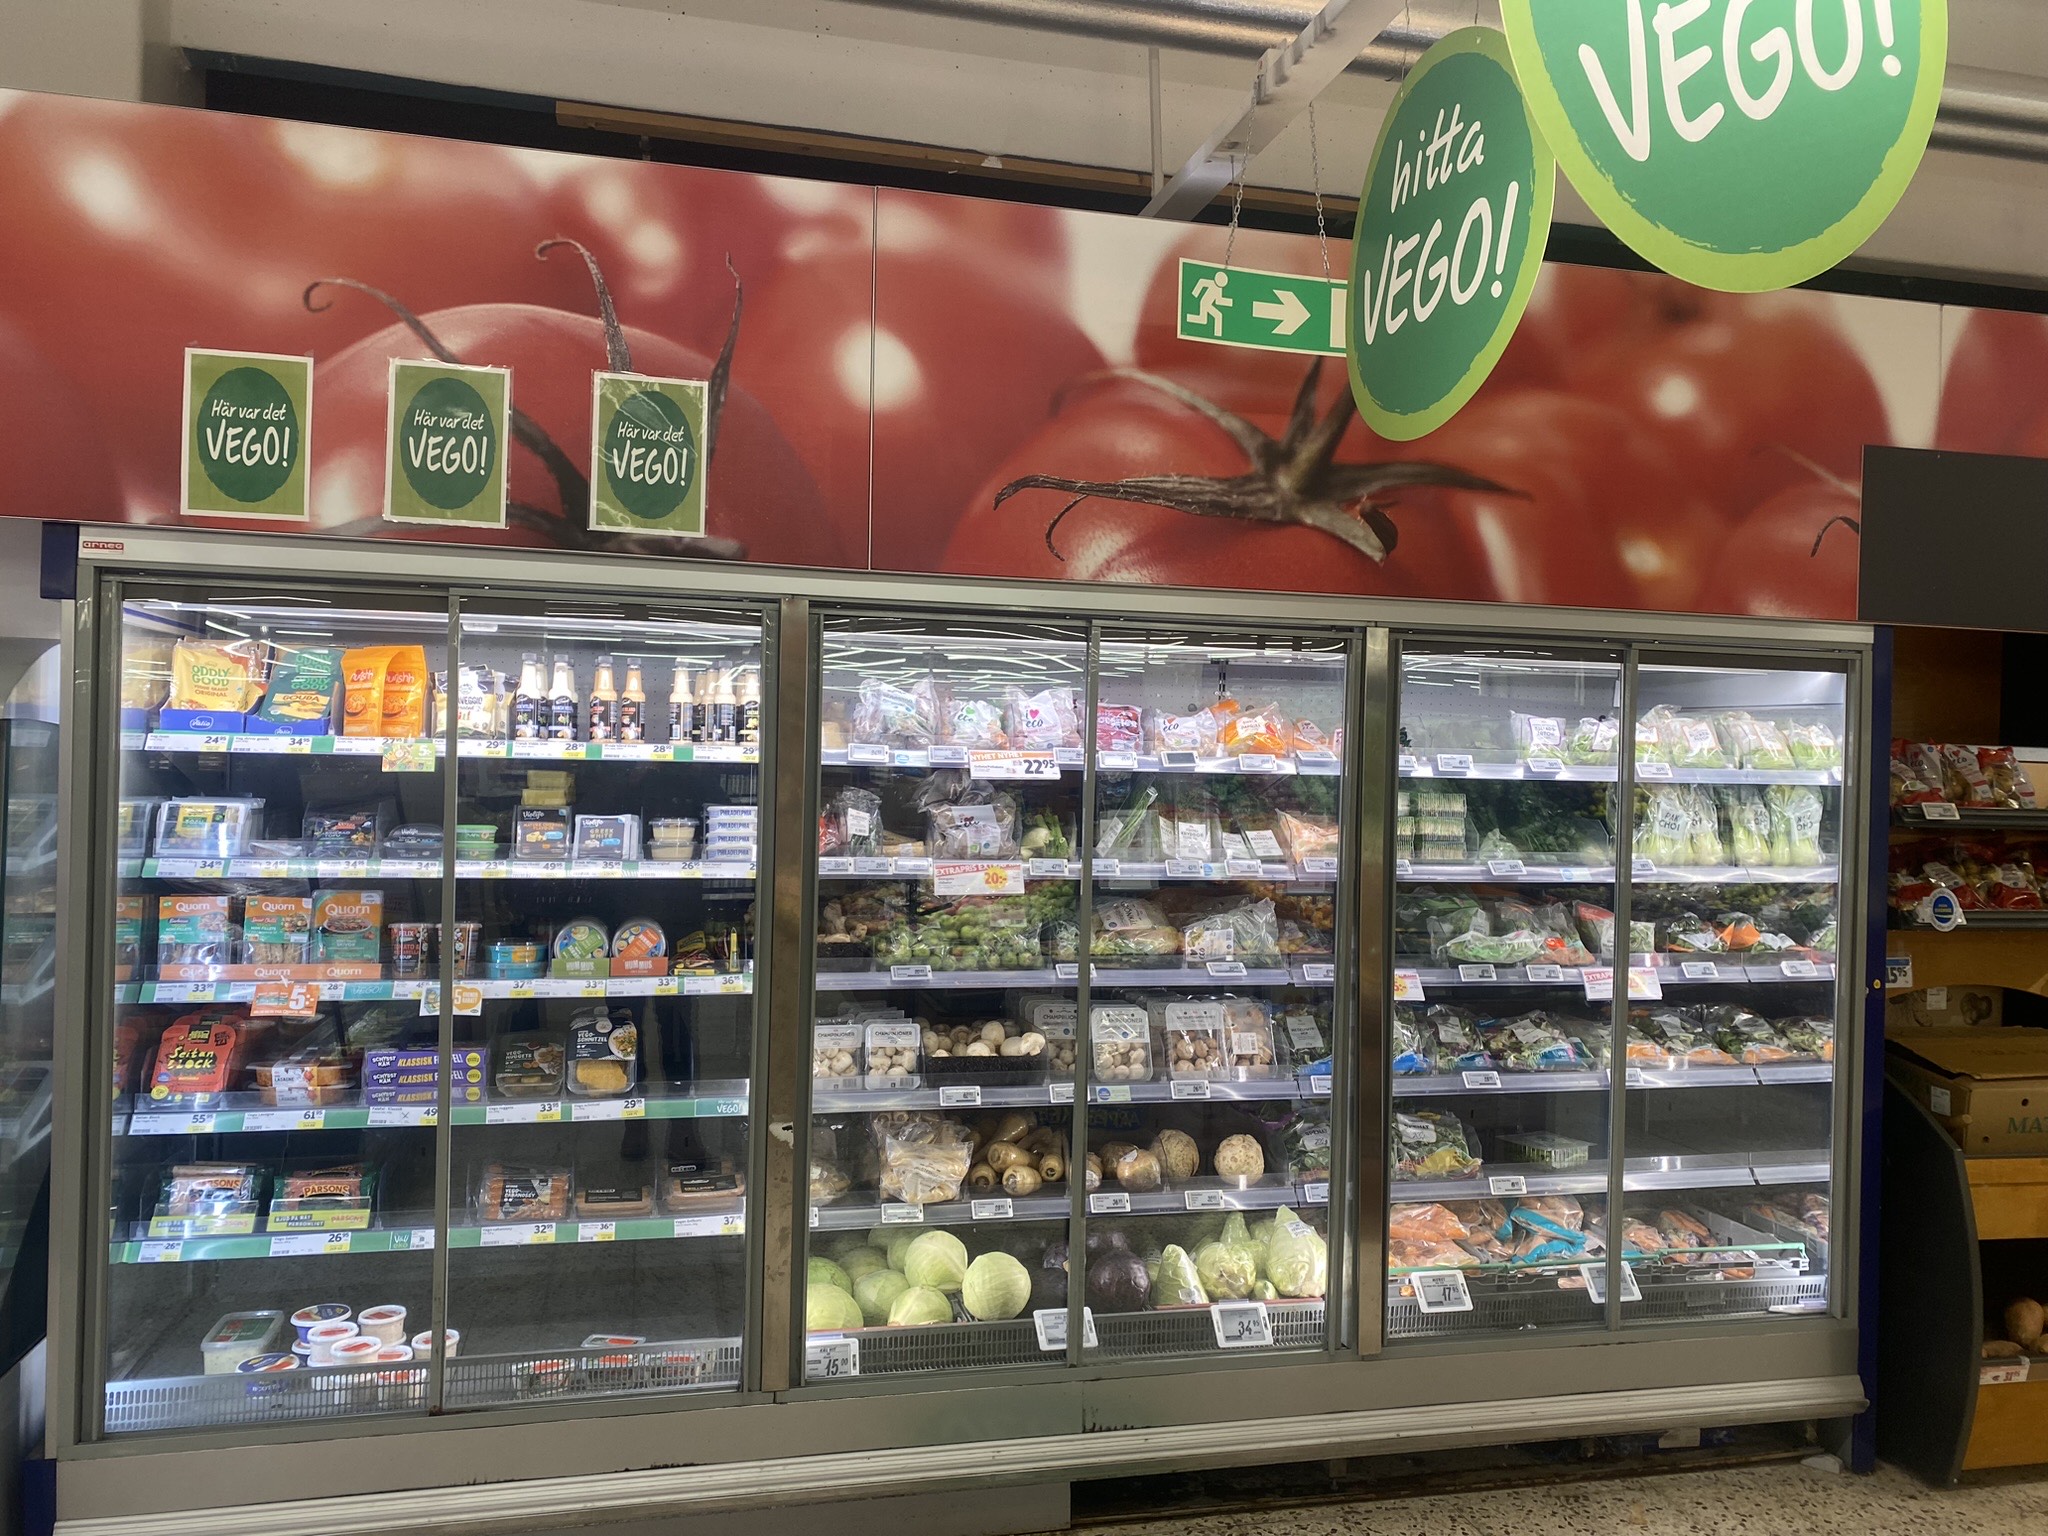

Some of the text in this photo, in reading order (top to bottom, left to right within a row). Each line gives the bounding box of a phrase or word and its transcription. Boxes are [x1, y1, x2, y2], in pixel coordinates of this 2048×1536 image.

[1578, 0, 1903, 162] VEGO!
[1389, 103, 1484, 213] hitta
[1363, 180, 1519, 346] VEGO!
[211, 399, 287, 421] Här var det
[413, 409, 485, 430] Här var det
[617, 421, 685, 442] Här var det
[206, 419, 291, 468] VEGO!
[408, 428, 488, 476] VEGO!
[612, 439, 688, 487] VEGO!
[191, 665, 231, 677] ODDLY
[191, 674, 230, 687] GOOD
[1026, 719, 1044, 728] eco
[1163, 723, 1179, 732] eco
[1665, 812, 1680, 822] PAK
[1659, 820, 1680, 831] CHOI
[936, 864, 978, 876] EXTRAPRIS
[175, 902, 210, 912] Quorn
[262, 902, 295, 912] Quorn
[325, 903, 370, 916] Quorn
[566, 962, 595, 971] HUMMUS
[624, 960, 653, 969] HUMMUS
[255, 967, 291, 977] Quorn
[327, 967, 362, 977] Quorn
[169, 1046, 214, 1058] Seitan
[397, 1056, 433, 1066] KLASSISK
[398, 1073, 433, 1083] KLASSISK
[397, 1092, 432, 1102] KLASSISK
[717, 1104, 741, 1113] VEGO!
